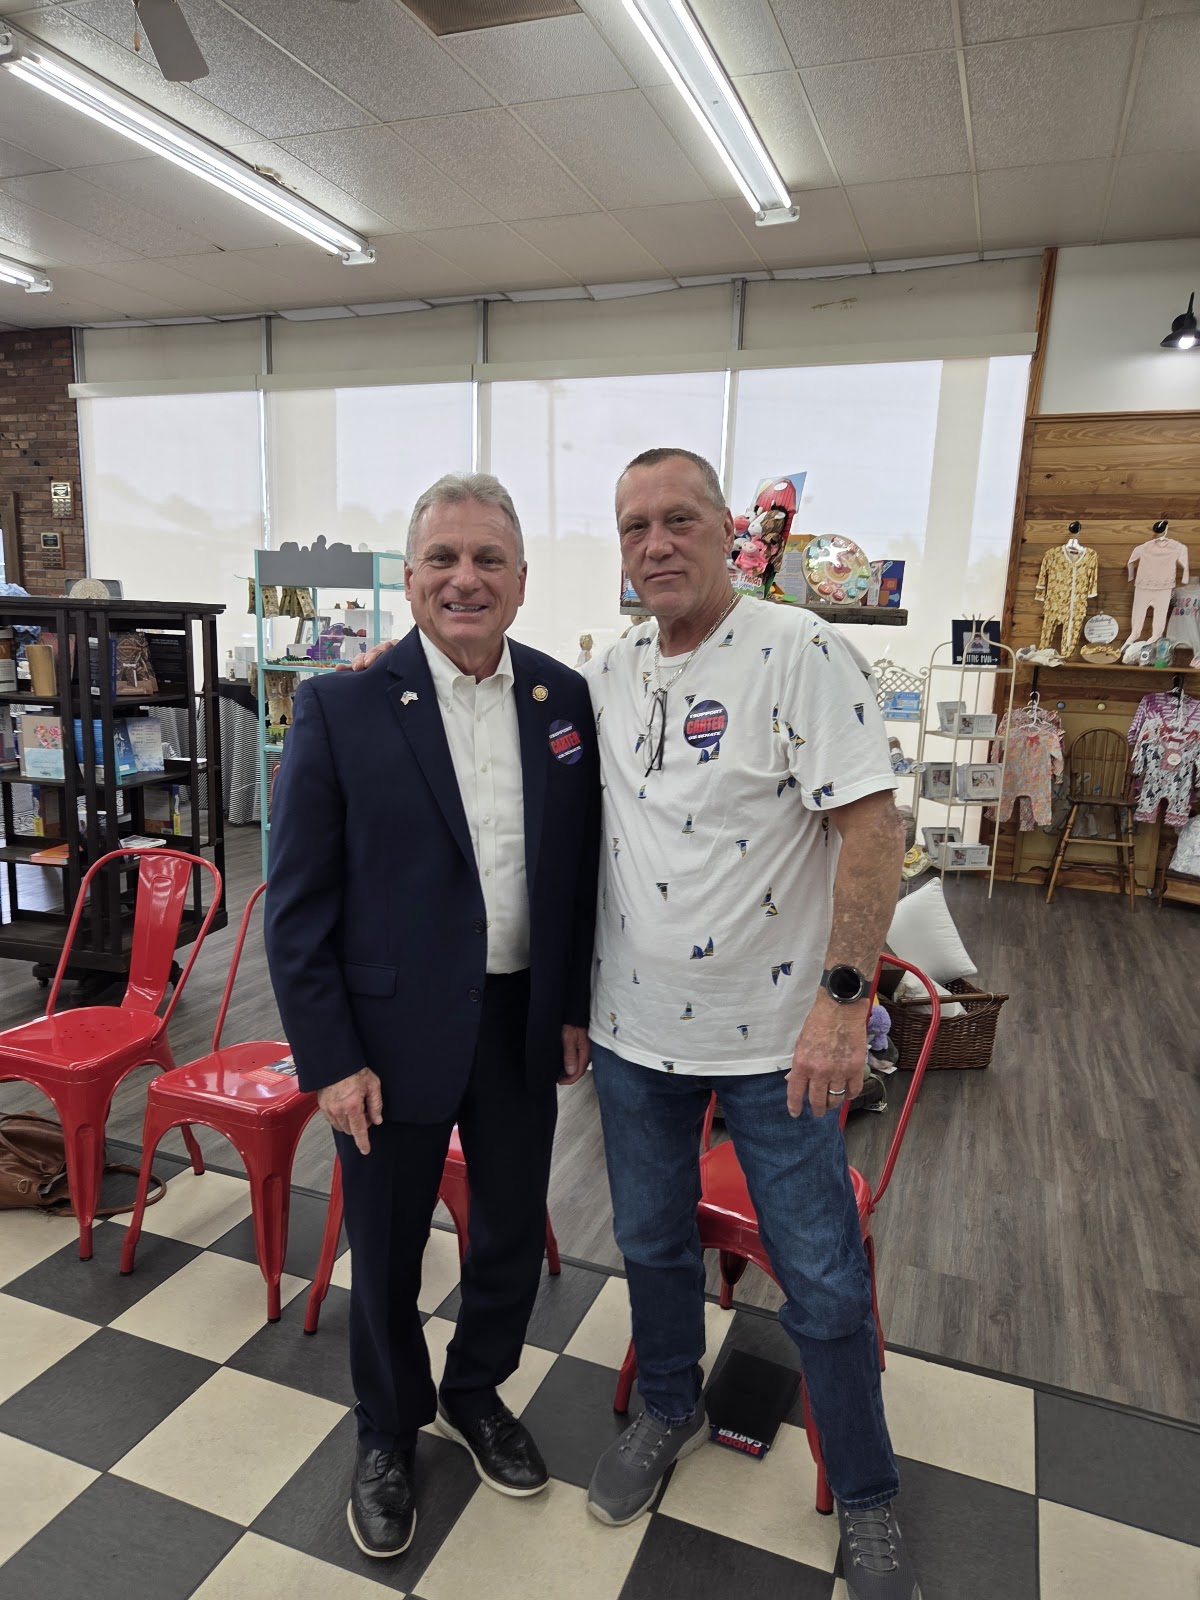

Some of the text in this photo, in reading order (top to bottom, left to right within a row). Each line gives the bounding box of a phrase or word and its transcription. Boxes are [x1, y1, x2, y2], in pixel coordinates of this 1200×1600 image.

[965, 654, 992, 664] ITTLE MAN
[693, 709, 723, 718] SUPPORT
[686, 716, 725, 734] CARTER
[551, 731, 581, 754] CARTER
[716, 1436, 760, 1455] BUDDY
[718, 1428, 763, 1448] CARTER
